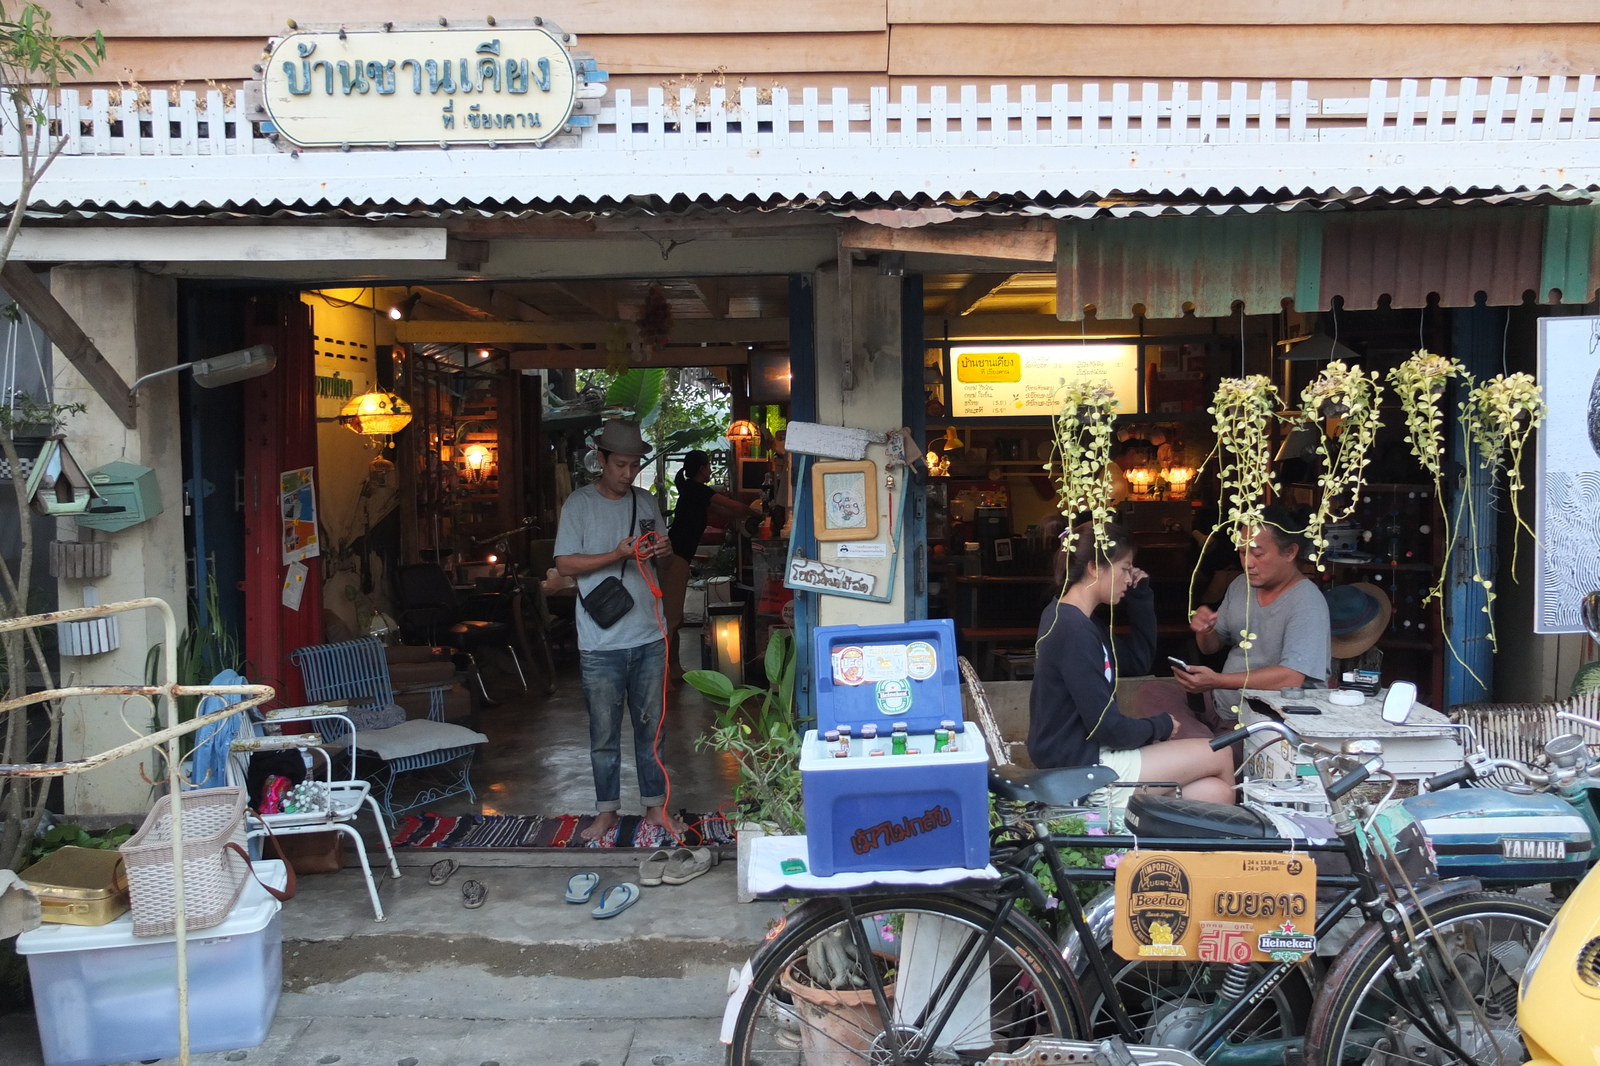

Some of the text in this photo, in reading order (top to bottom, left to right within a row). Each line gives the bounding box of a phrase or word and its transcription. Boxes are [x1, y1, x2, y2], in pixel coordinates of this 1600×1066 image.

[282, 39, 550, 95] บ้านชานเคียง
[442, 99, 542, 129] ที่ เชียงคาน
[961, 356, 1014, 367] บ้านชานเคียง
[1503, 840, 1565, 859] YAMAHA
[1144, 863, 1177, 875] IMPORTED
[1289, 862, 1300, 870] 24
[1136, 894, 1185, 907] Beerlao
[1261, 937, 1313, 949] Heineken
